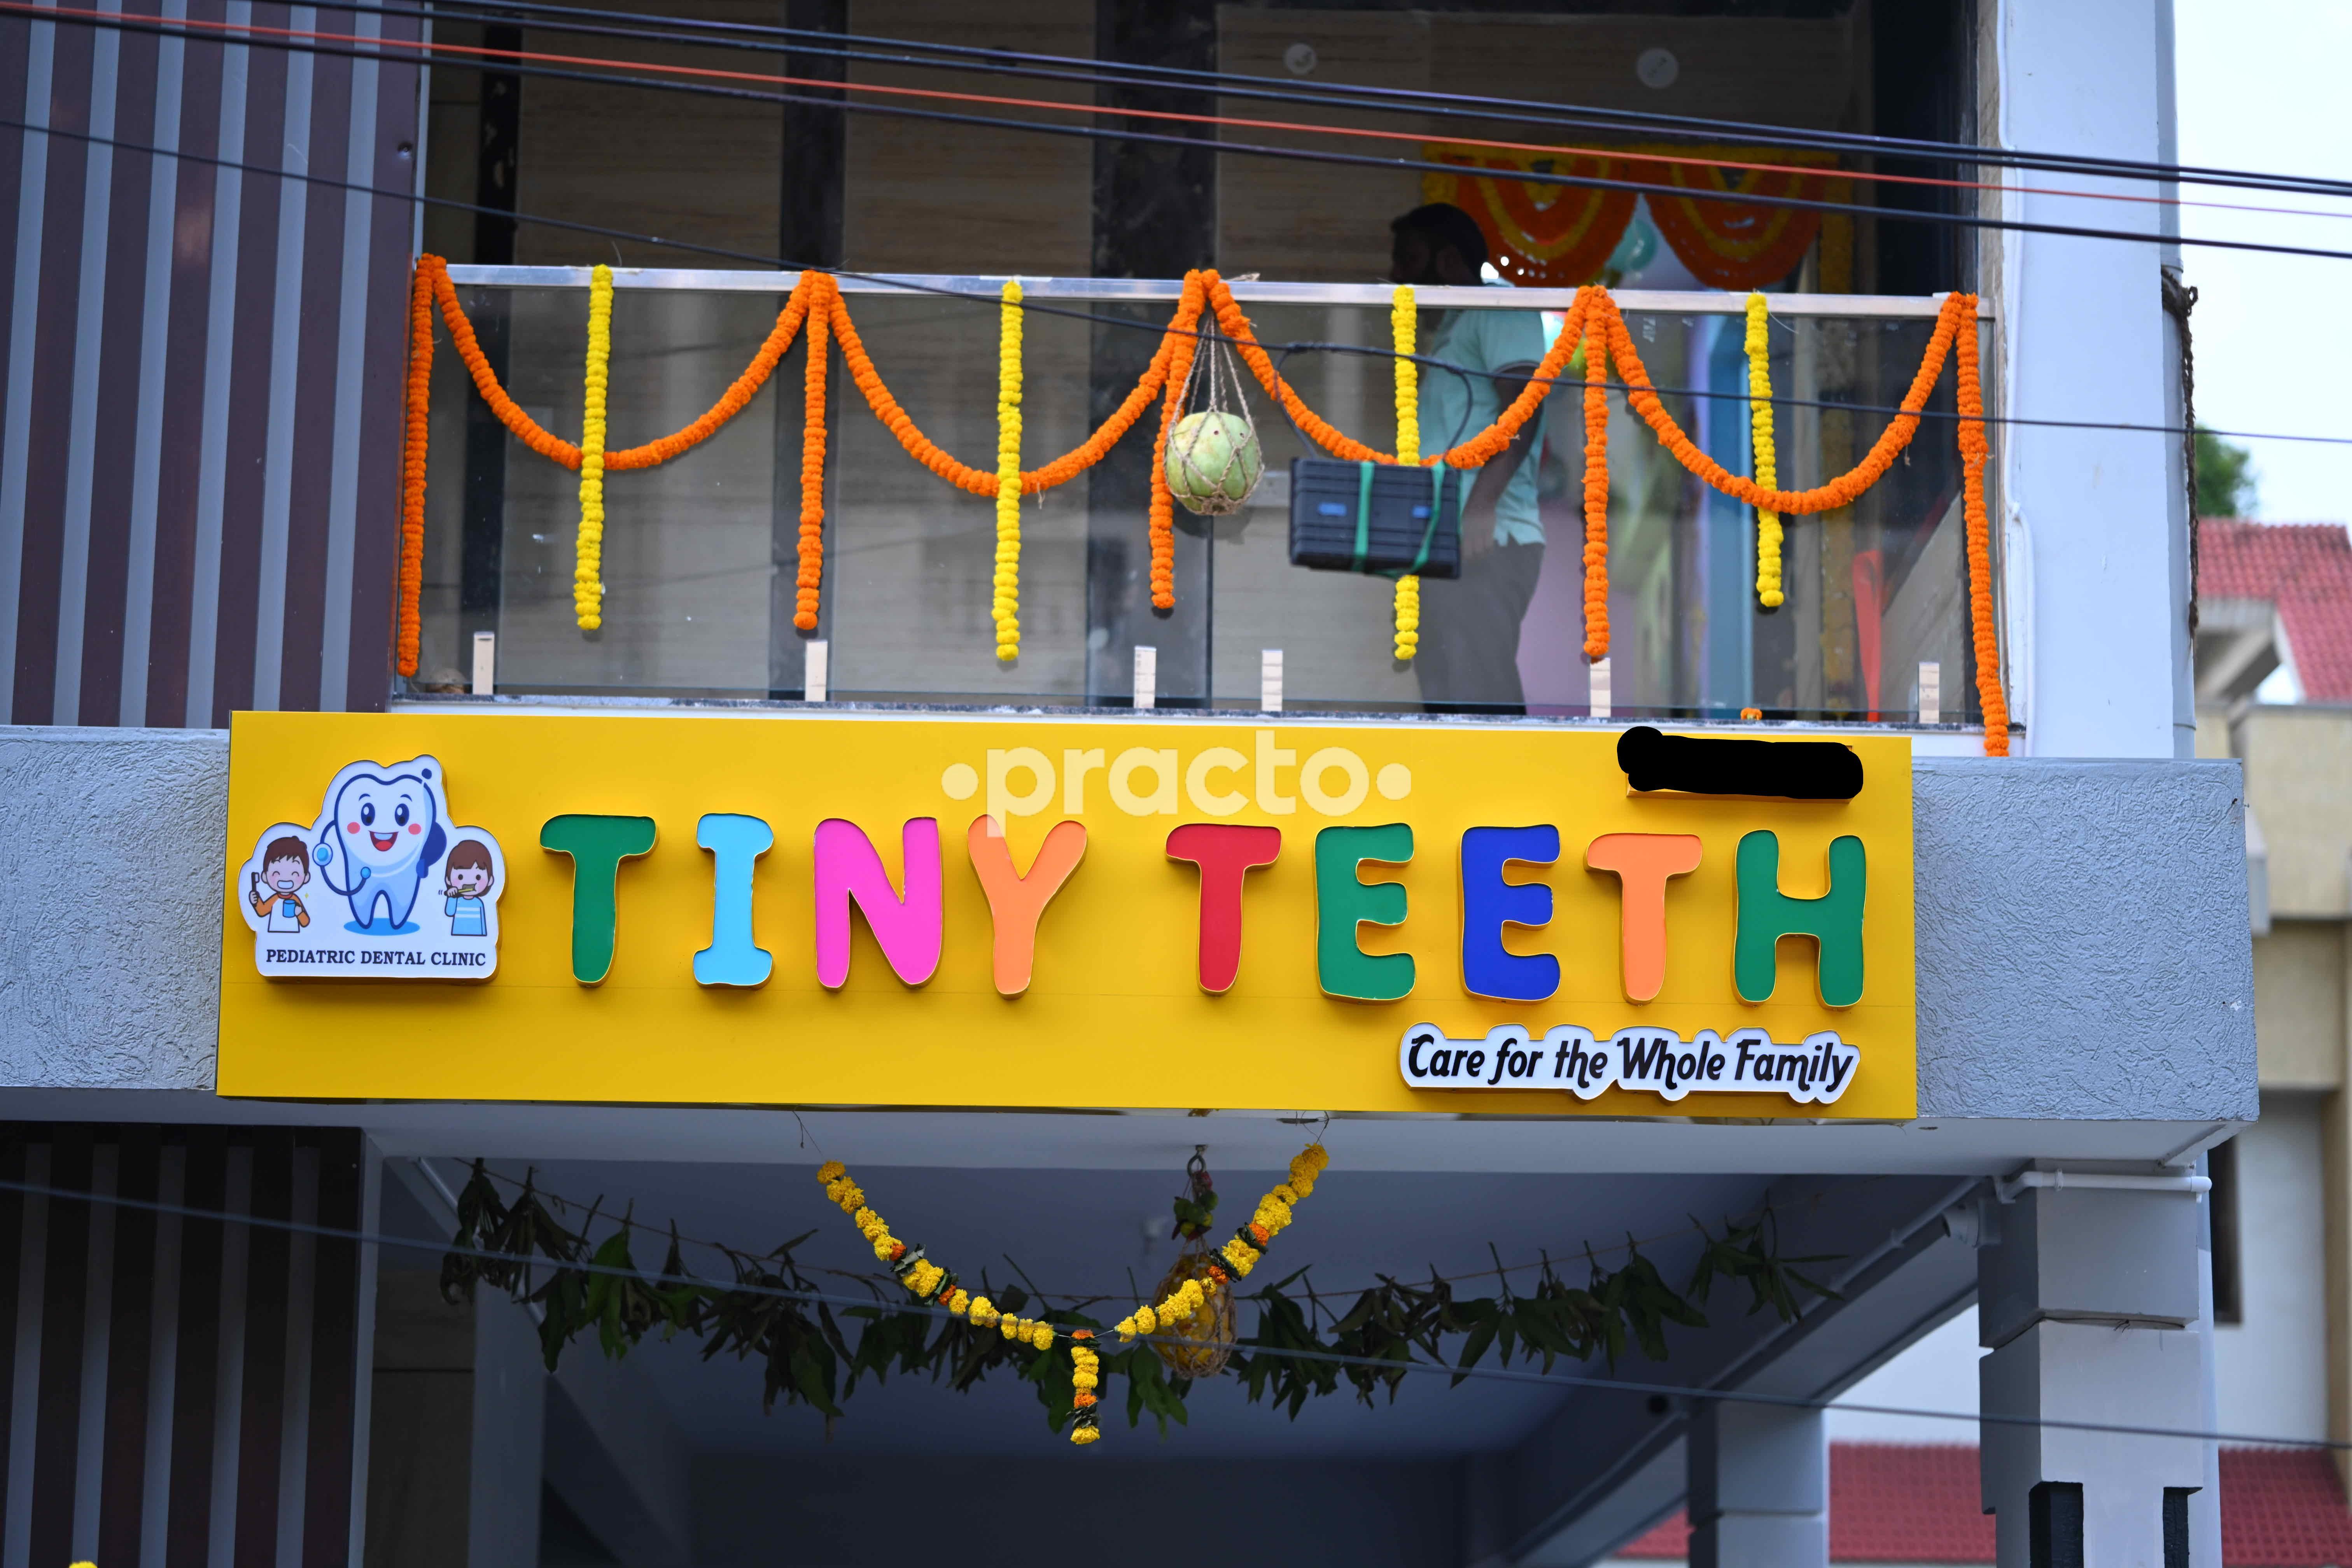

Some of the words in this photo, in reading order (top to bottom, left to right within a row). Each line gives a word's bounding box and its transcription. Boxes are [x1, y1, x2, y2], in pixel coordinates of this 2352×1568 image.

[539, 812, 1088, 999] TINY
[1166, 822, 1867, 1009] TEETH
[266, 949, 355, 964] PEDIATRIC
[360, 950, 426, 965] DENTAL
[430, 952, 486, 966] CLINIC
[1408, 1033, 1485, 1078] Care
[1488, 1037, 1544, 1085] for
[1555, 1038, 1608, 1088] the
[1617, 1037, 1726, 1089] Whole
[1734, 1039, 1854, 1092] Family
